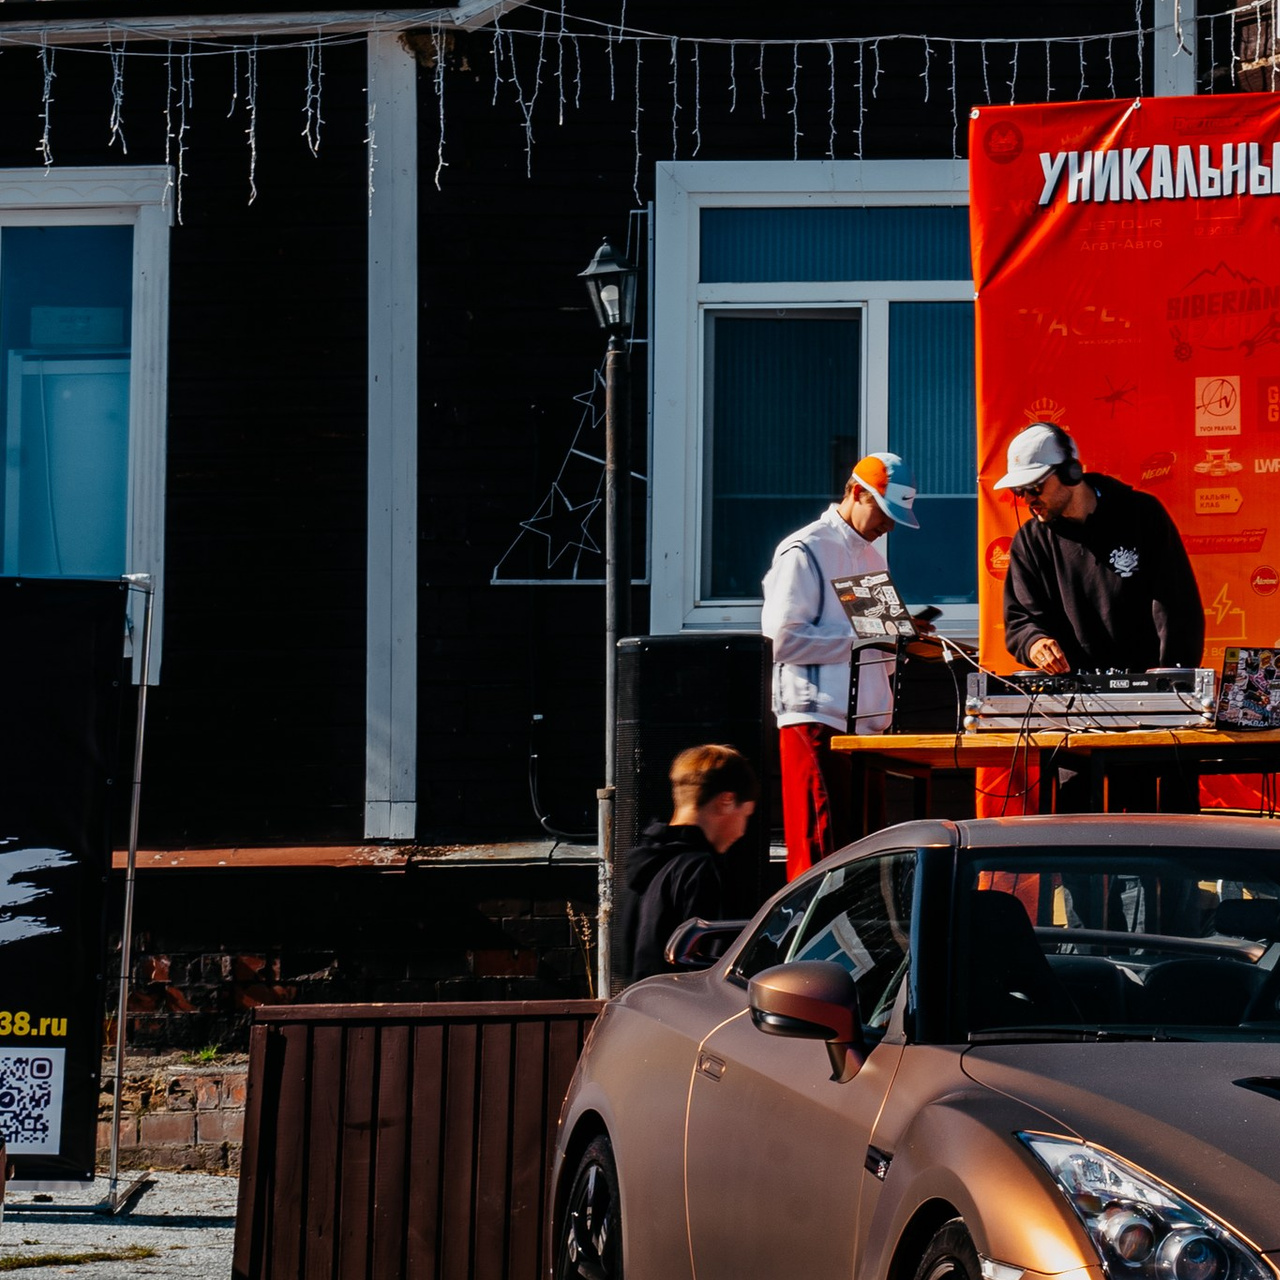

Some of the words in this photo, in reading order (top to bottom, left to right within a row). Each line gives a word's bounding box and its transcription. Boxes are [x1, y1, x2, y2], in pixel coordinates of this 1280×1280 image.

[1080, 239, 1163, 252] Агат-Авто
[1166, 285, 1280, 321] SIBERIAN
[1141, 465, 1172, 481] NEON
[1199, 493, 1230, 501] КАЛЬЯН
